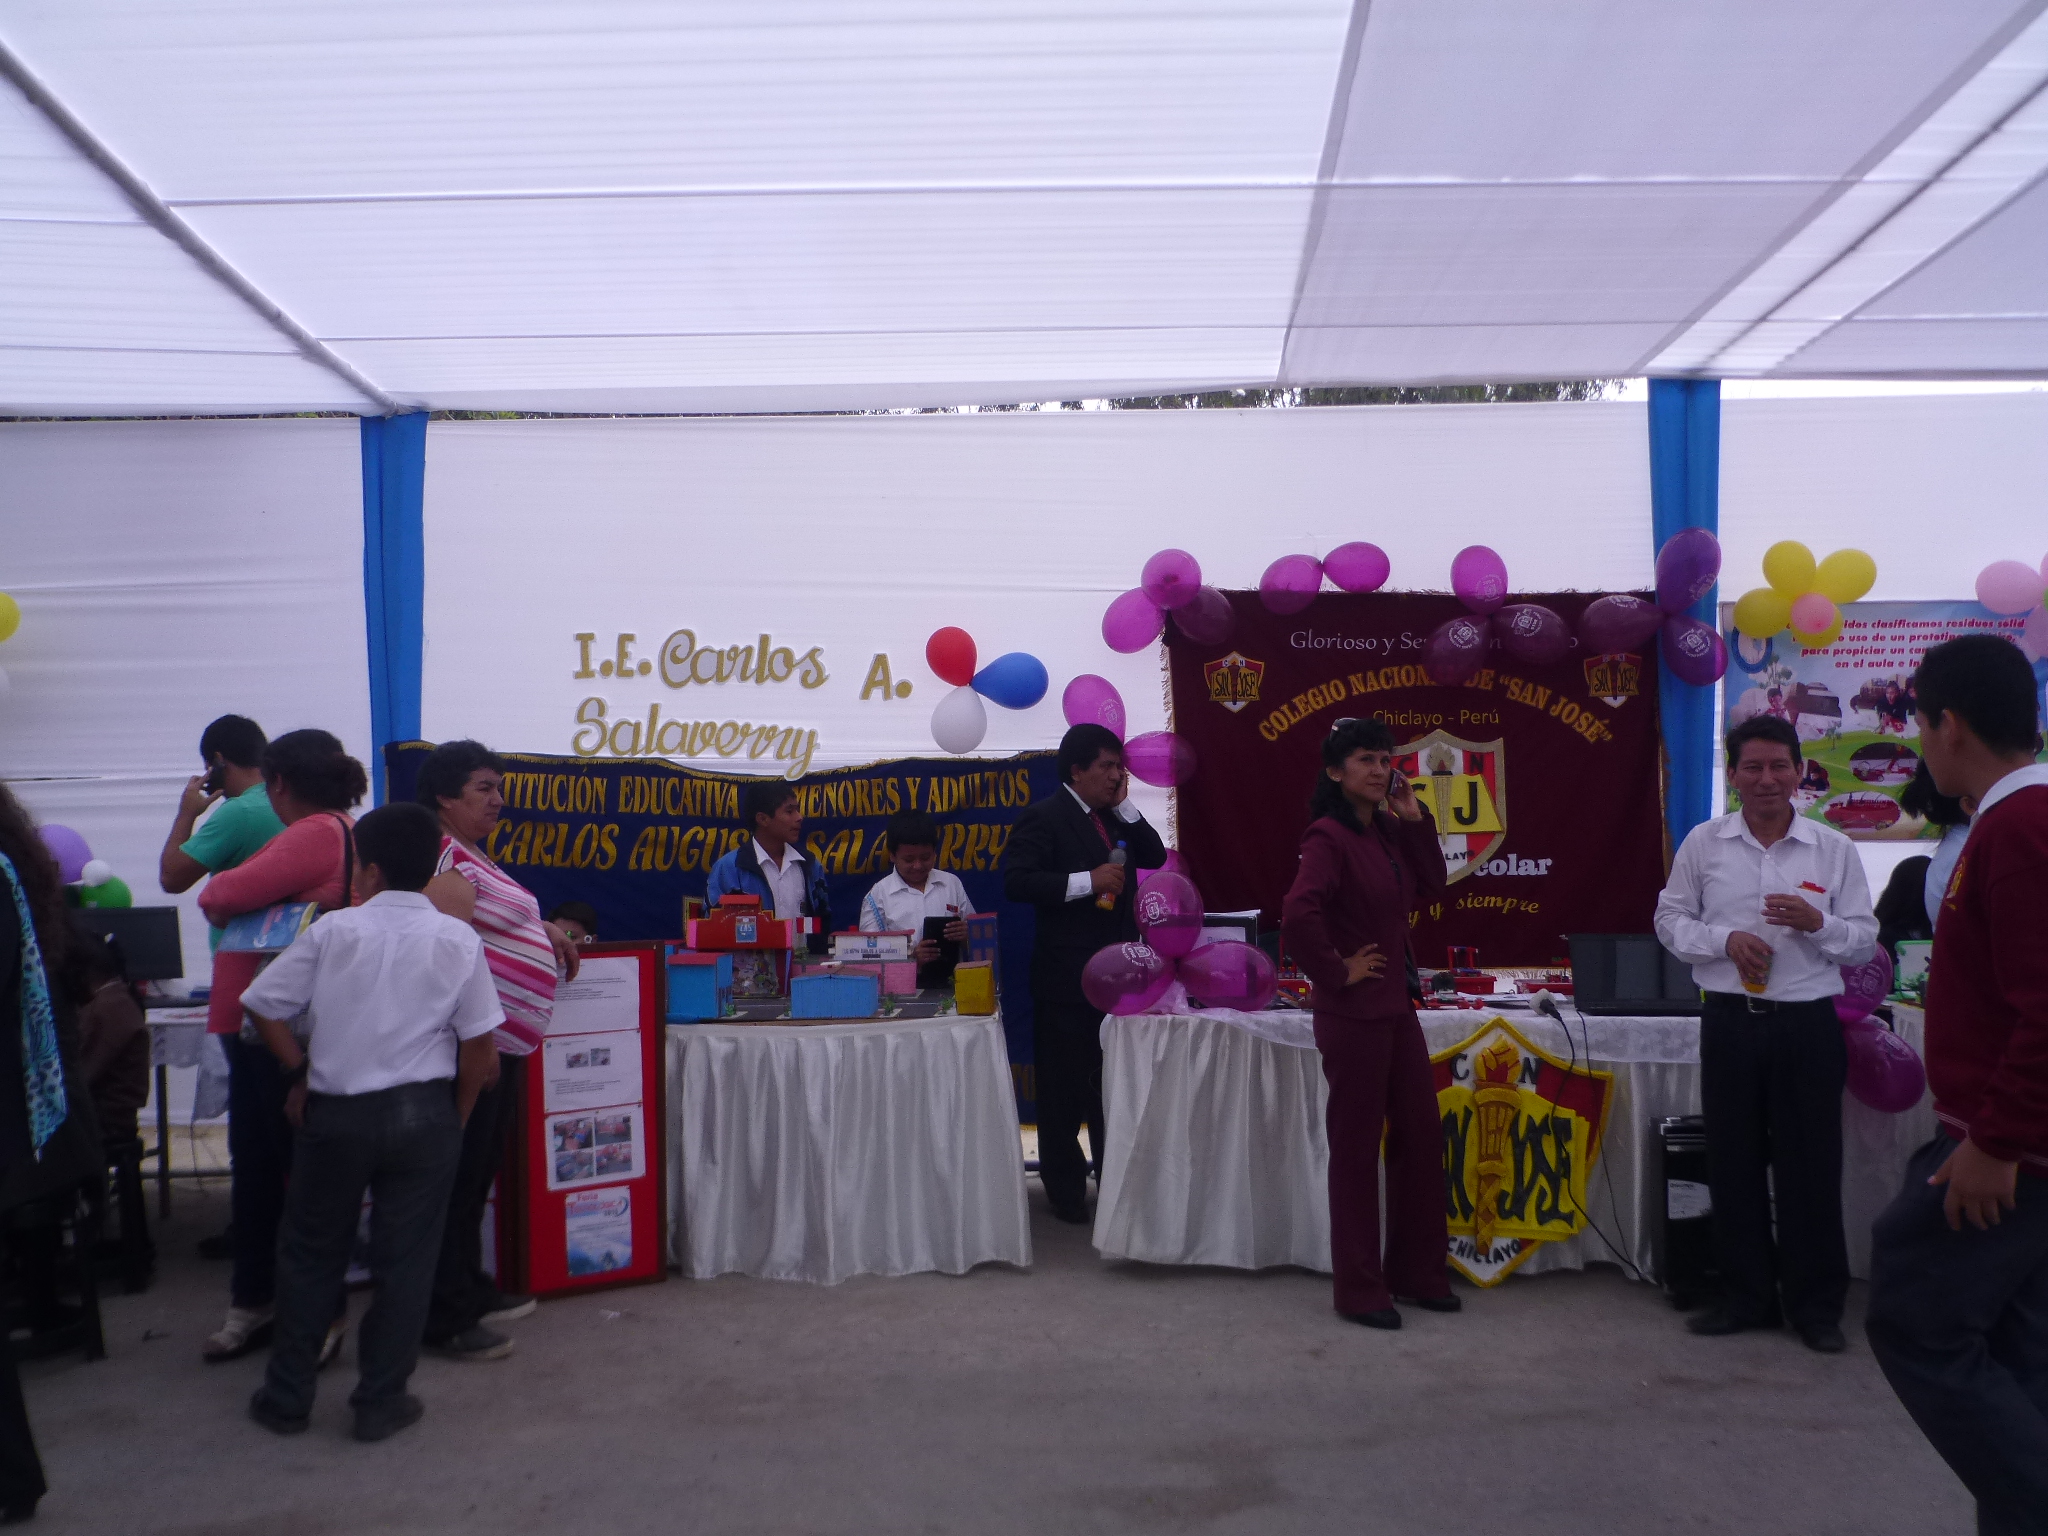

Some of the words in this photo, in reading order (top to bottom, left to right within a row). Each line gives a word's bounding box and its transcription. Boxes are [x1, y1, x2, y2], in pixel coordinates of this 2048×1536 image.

[1843, 619, 1868, 629] idos
[1290, 629, 1377, 650] Glorioso
[1382, 636, 1395, 656] y
[1801, 647, 1829, 656] para
[1833, 645, 1886, 657] propiciar
[574, 632, 652, 679] I.E.
[659, 629, 830, 689] Carlos
[861, 653, 914, 700] A.
[1258, 679, 1347, 741] COLEGIO
[1348, 664, 1436, 696] NACION
[1460, 709, 1499, 724] Perú
[572, 696, 821, 781] Salaverry
[1469, 754, 1484, 774] N
[502, 767, 607, 814] TITUCIÓN
[618, 776, 740, 819] EDUCATIVA
[905, 776, 921, 813] Y
[926, 768, 1031, 814] ADULTOS
[1453, 782, 1478, 825] J
[487, 819, 619, 870] CARLOS
[629, 826, 749, 872] AUGUS
[1445, 852, 1474, 861] LAYO
[1473, 853, 1553, 877] colar
[1455, 892, 1540, 914] siempre
[1452, 1053, 1470, 1080] C
[1518, 1056, 1541, 1085] N
